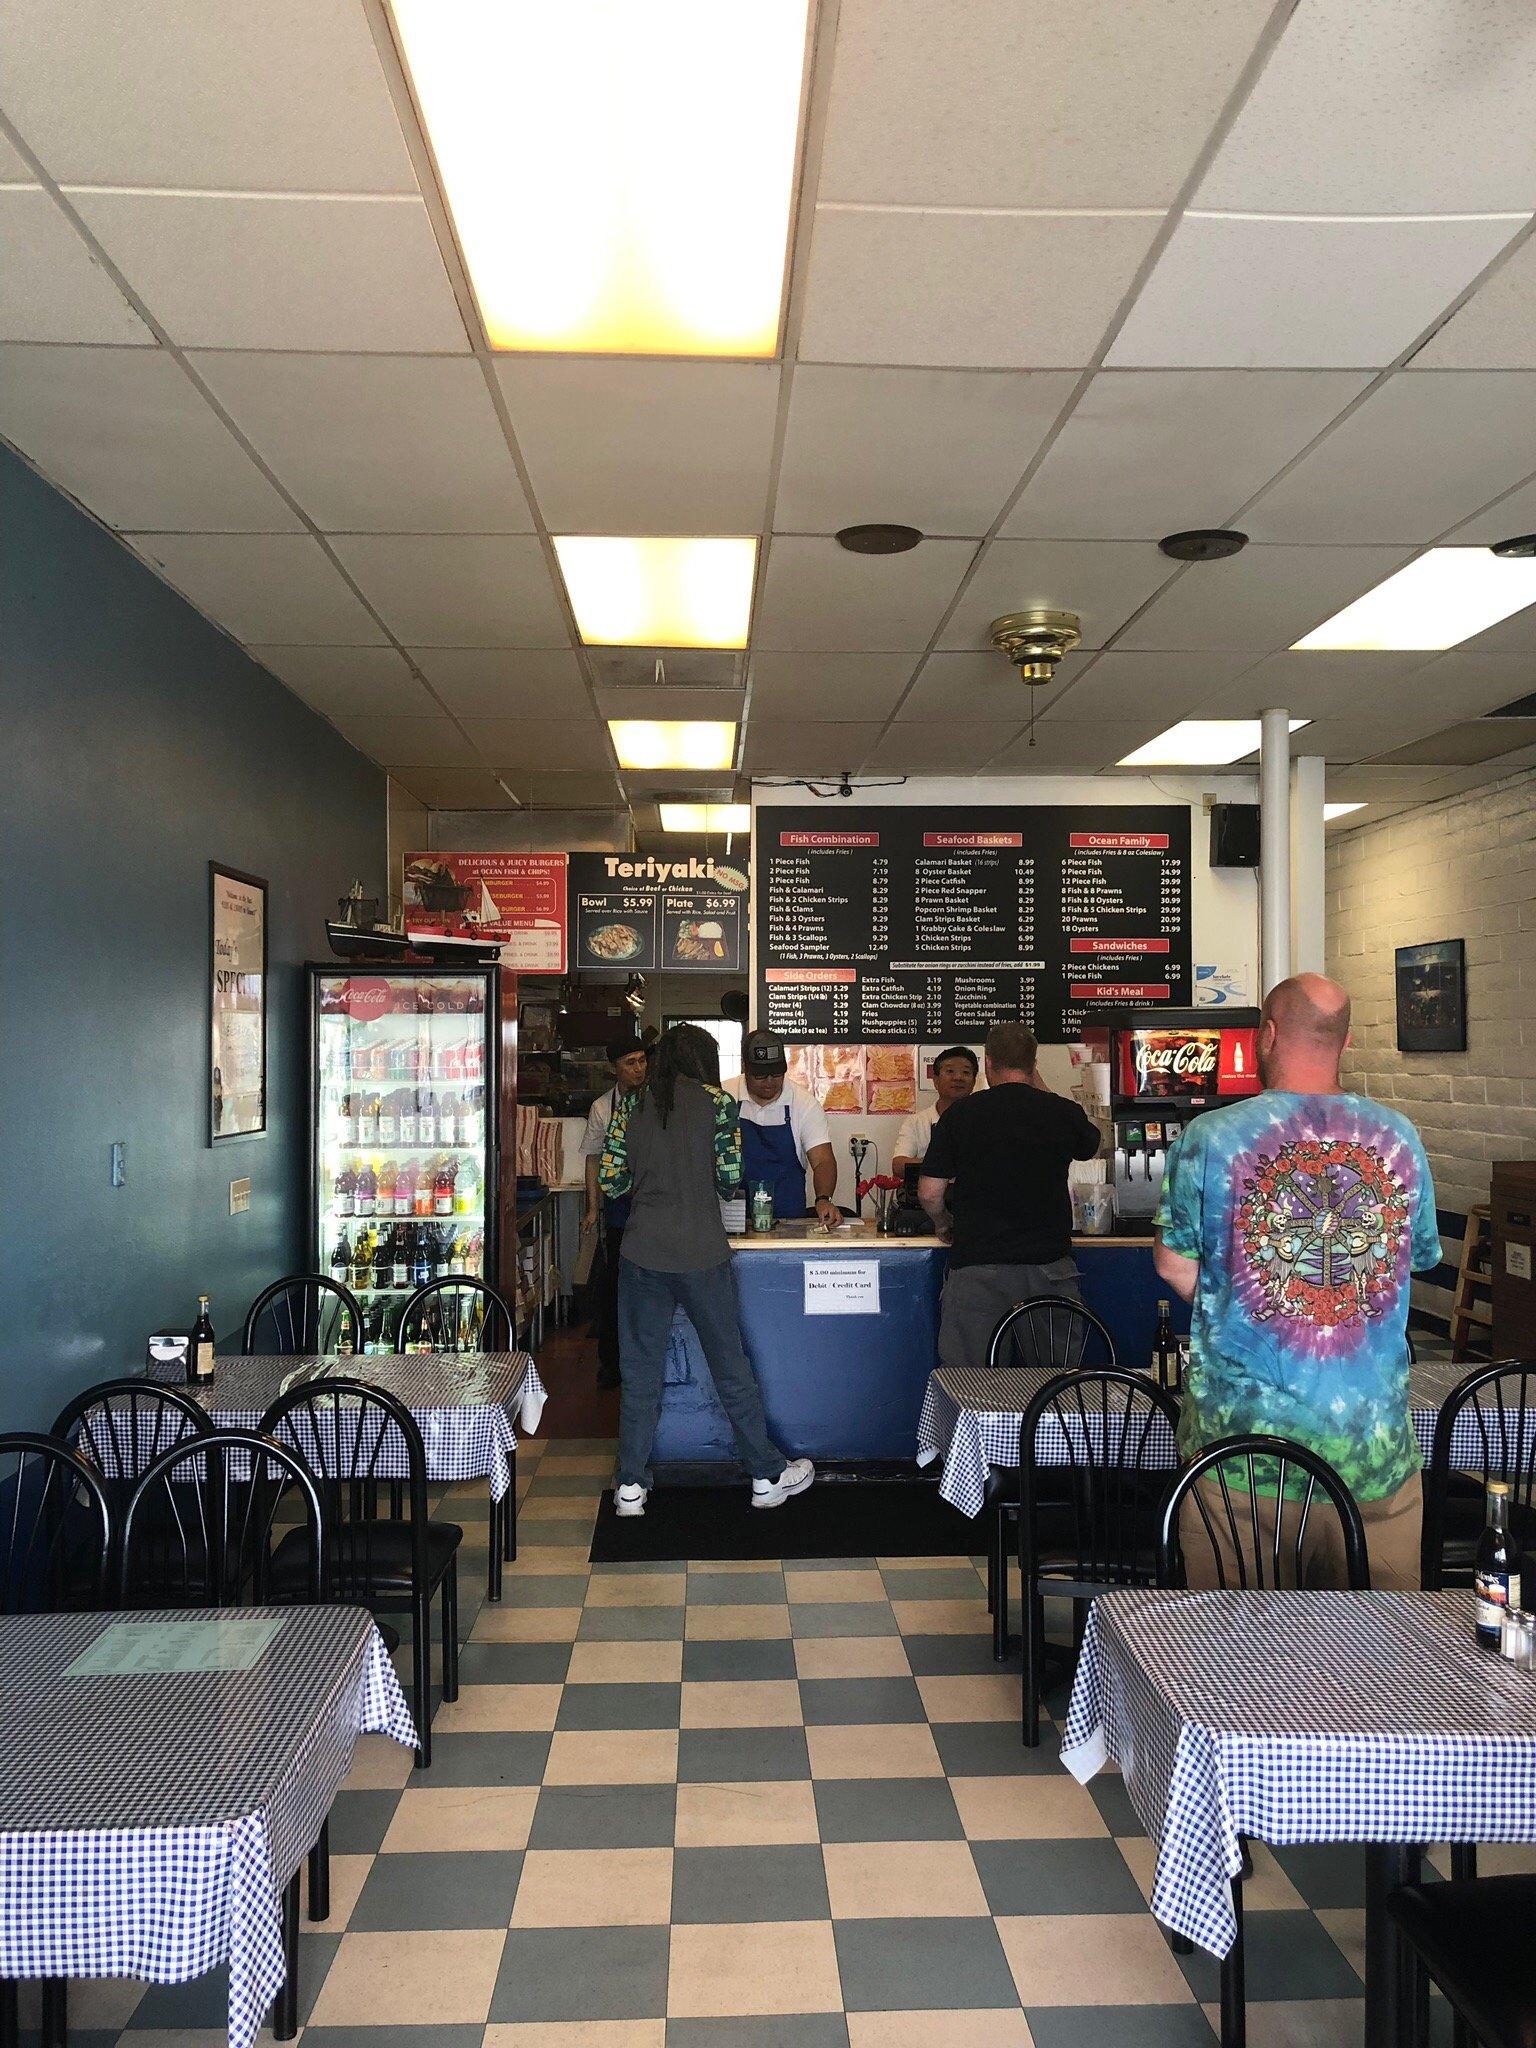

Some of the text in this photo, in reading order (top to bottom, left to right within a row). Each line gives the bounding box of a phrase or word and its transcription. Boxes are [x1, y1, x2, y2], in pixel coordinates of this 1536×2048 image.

[790, 835, 871, 844] Fish Combination
[936, 835, 1013, 844] Seafood Baskets
[1089, 836, 1150, 848] Ocean Family
[604, 856, 715, 883] Teriyaki
[922, 868, 946, 876] Oyster
[716, 869, 745, 890] NO MSG
[956, 887, 986, 895] Snapper
[582, 897, 606, 906] Bowl
[623, 898, 652, 907] $5.99
[667, 898, 693, 907] Plate
[706, 898, 735, 908] $6.99
[915, 906, 944, 914] Popcorn
[946, 906, 972, 914] Shrimp
[1072, 925, 1099, 933] Oysters
[1093, 942, 1147, 950] Sandwiches
[784, 971, 838, 980] Side Orders
[977, 985, 996, 993] Rings
[1097, 987, 1143, 995] Kid's Meal
[344, 988, 388, 1004] Coca-Cola
[395, 1001, 464, 1011] ICE COLD
[769, 1002, 791, 1010] Oyster
[955, 1009, 975, 1017] Green
[1136, 1042, 1218, 1074] Coca-Cola
